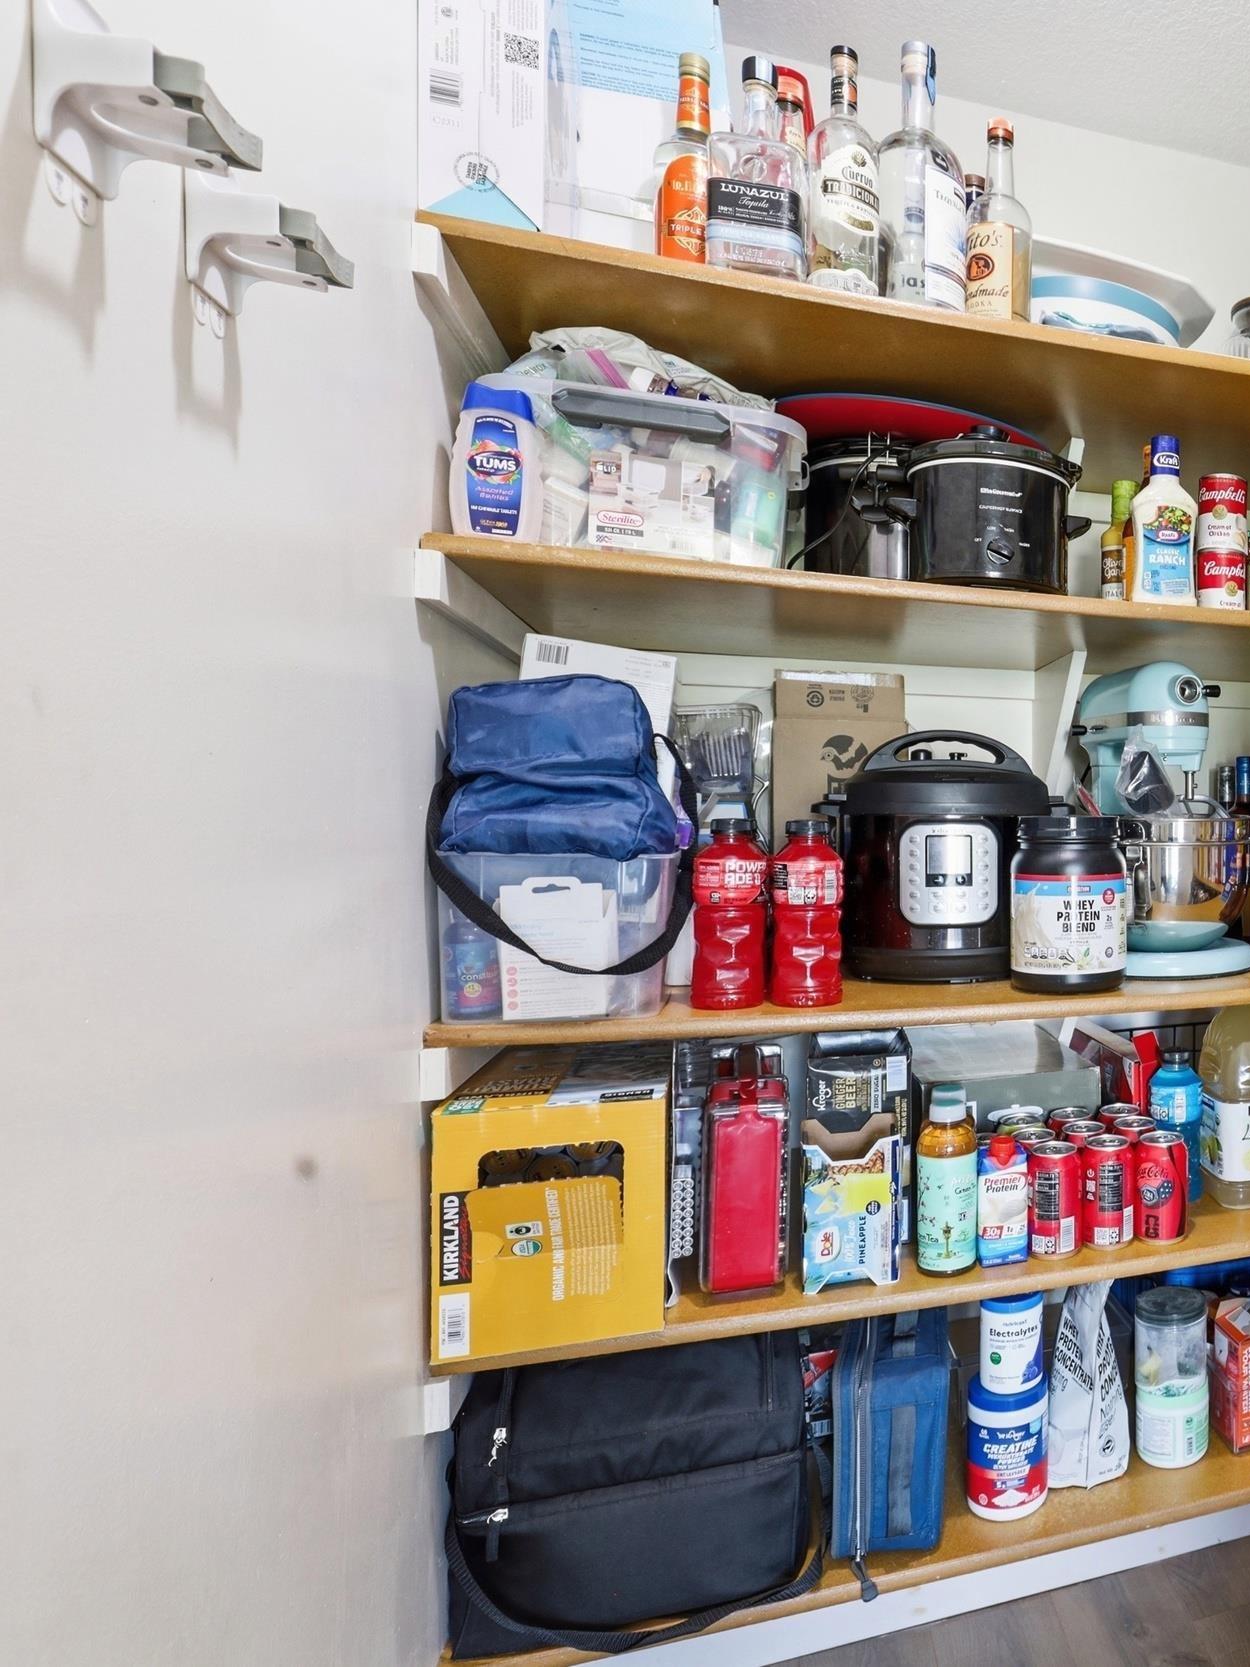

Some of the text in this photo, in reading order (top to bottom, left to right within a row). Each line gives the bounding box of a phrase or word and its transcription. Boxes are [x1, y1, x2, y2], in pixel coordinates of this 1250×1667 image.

[842, 166, 874, 190] Cuervo
[719, 182, 789, 202] LUNAZUL
[738, 196, 769, 209] Tequila
[670, 223, 702, 235] TRIPLE
[473, 456, 517, 472] TUMS
[1160, 454, 1179, 467] Kraft
[1199, 486, 1246, 504] Campbell's
[602, 512, 642, 526] Sterilite
[1149, 555, 1186, 567] RANCH
[1063, 899, 1094, 911] WHEY
[1056, 911, 1101, 922] PROTEIN
[1062, 922, 1096, 933] BLEND
[812, 1079, 832, 1112] Kroger
[836, 1077, 847, 1110] GINGER
[845, 1076, 856, 1109] BEER
[984, 1175, 1021, 1187] Premier
[985, 1184, 1019, 1194] Protein
[443, 1195, 460, 1282] KIRKLAND
[551, 1235, 564, 1249] FAIR
[820, 1231, 832, 1257] Dole
[858, 1215, 867, 1265] PINEAPPLE
[552, 1265, 565, 1301] ORGANIC
[988, 1325, 1039, 1338] Electrolytes
[1062, 1315, 1080, 1340] WHEY
[1054, 1346, 1094, 1391] CONCENTRATE
[983, 1434, 1039, 1453] CREATINE
